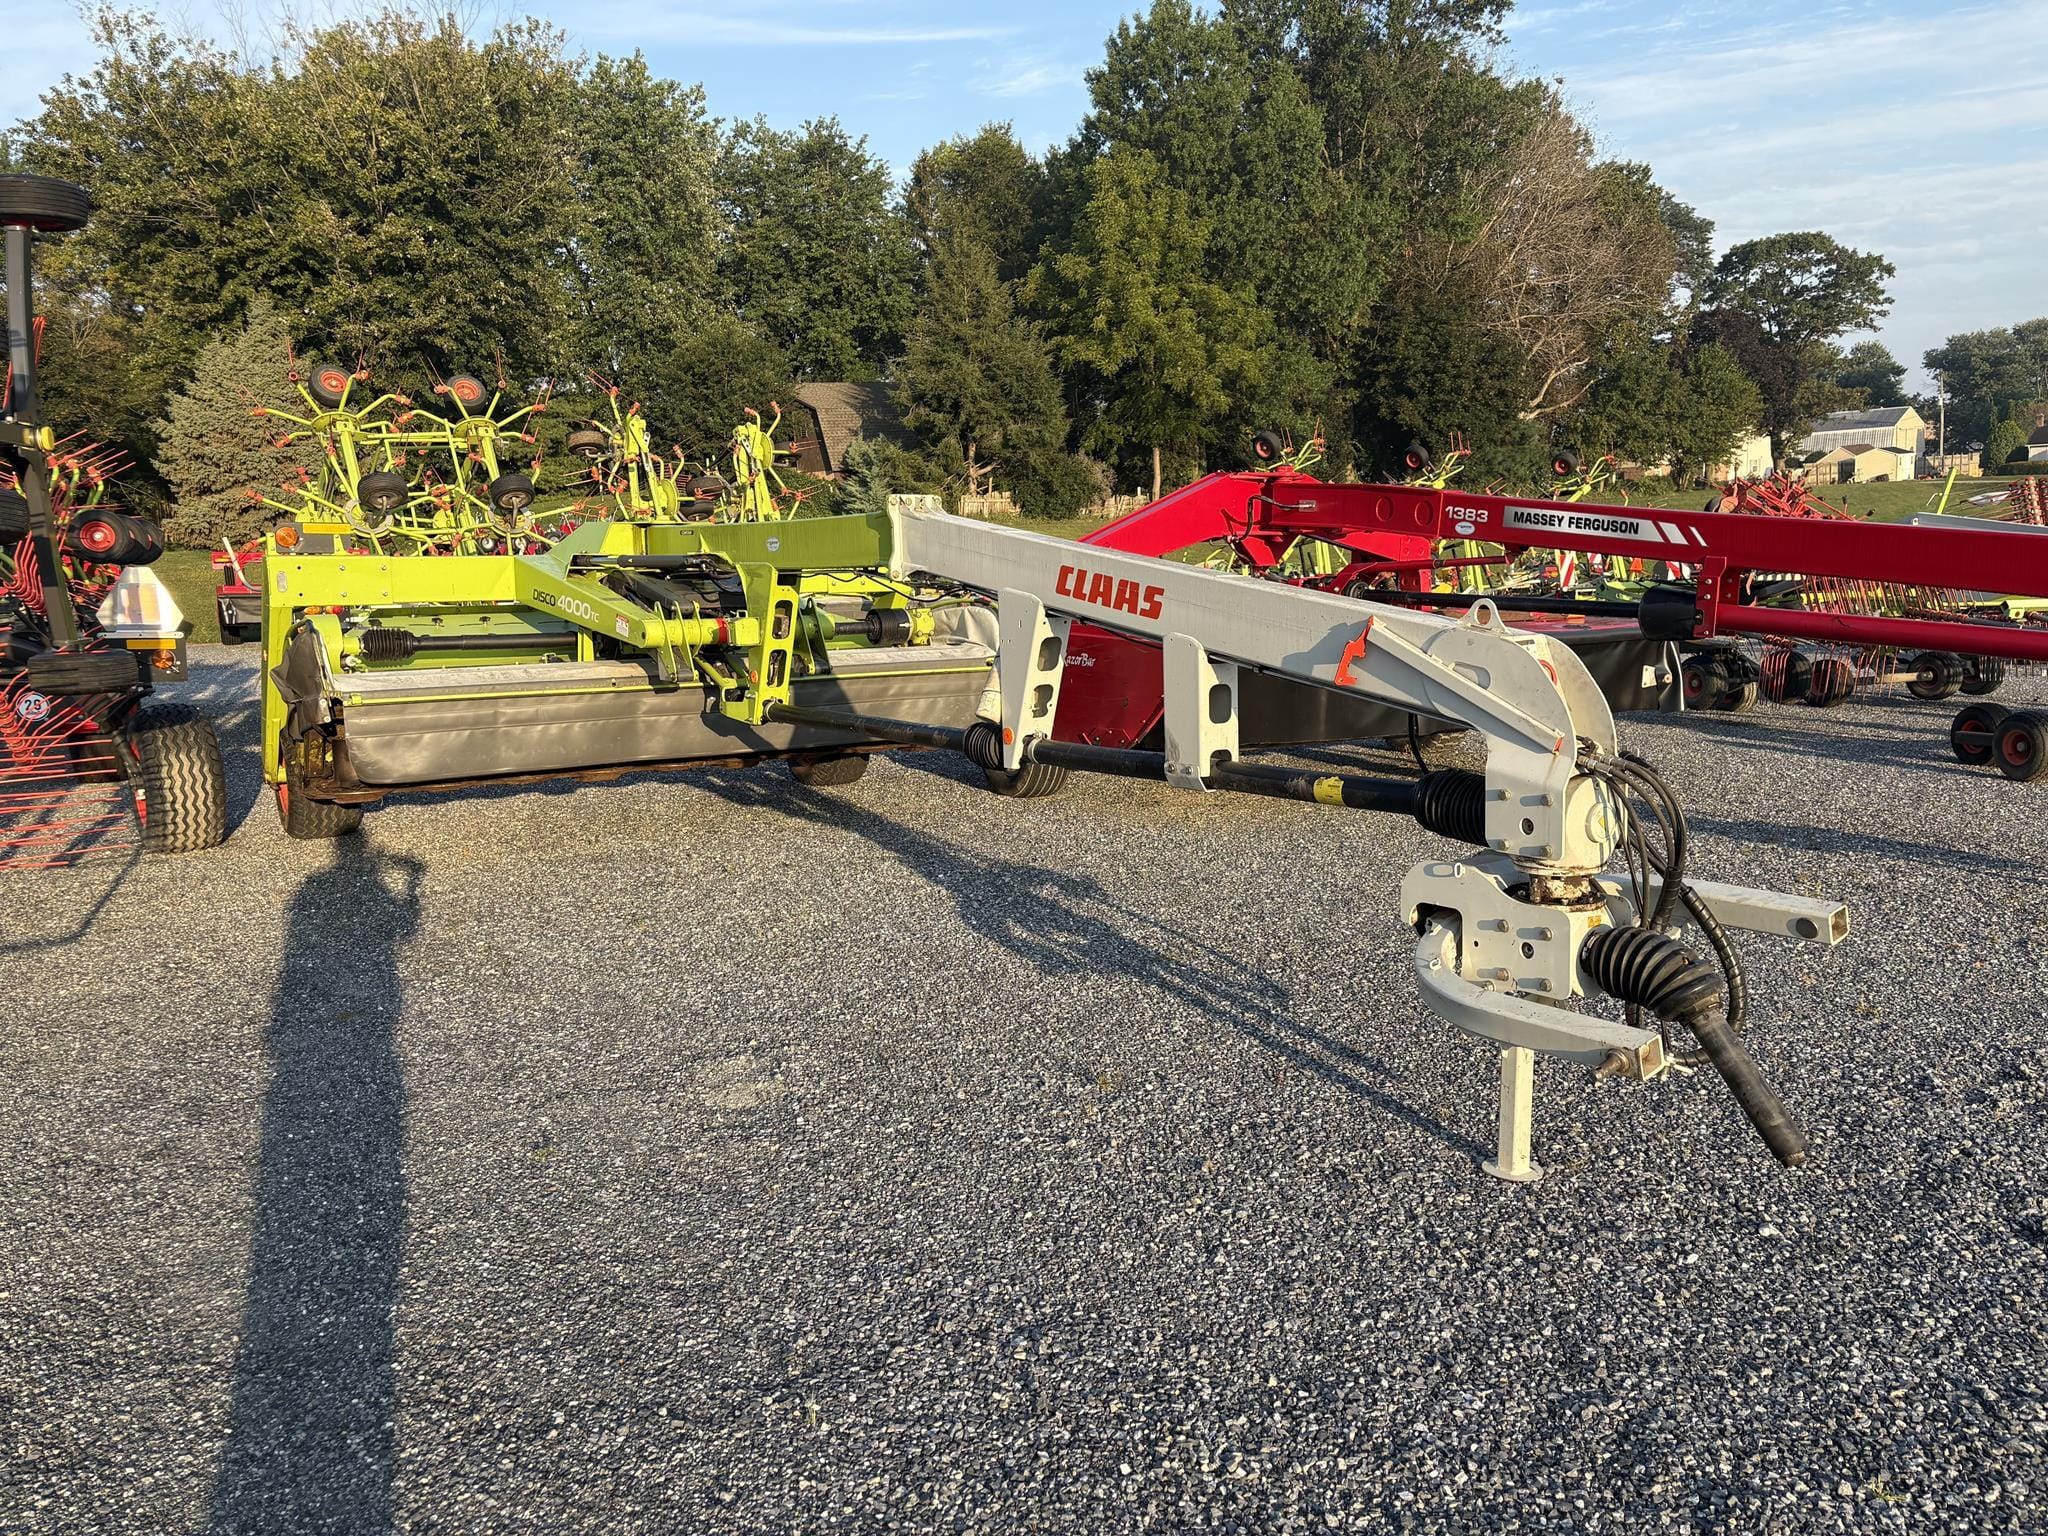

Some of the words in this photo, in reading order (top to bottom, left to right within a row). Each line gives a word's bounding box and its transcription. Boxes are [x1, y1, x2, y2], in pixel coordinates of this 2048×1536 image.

[1445, 505, 1488, 522] 1383
[1513, 511, 1565, 528] MASSEY
[1568, 516, 1639, 535] FERGUSON
[532, 588, 556, 607] DISCO
[1055, 565, 1165, 620] CLAAS
